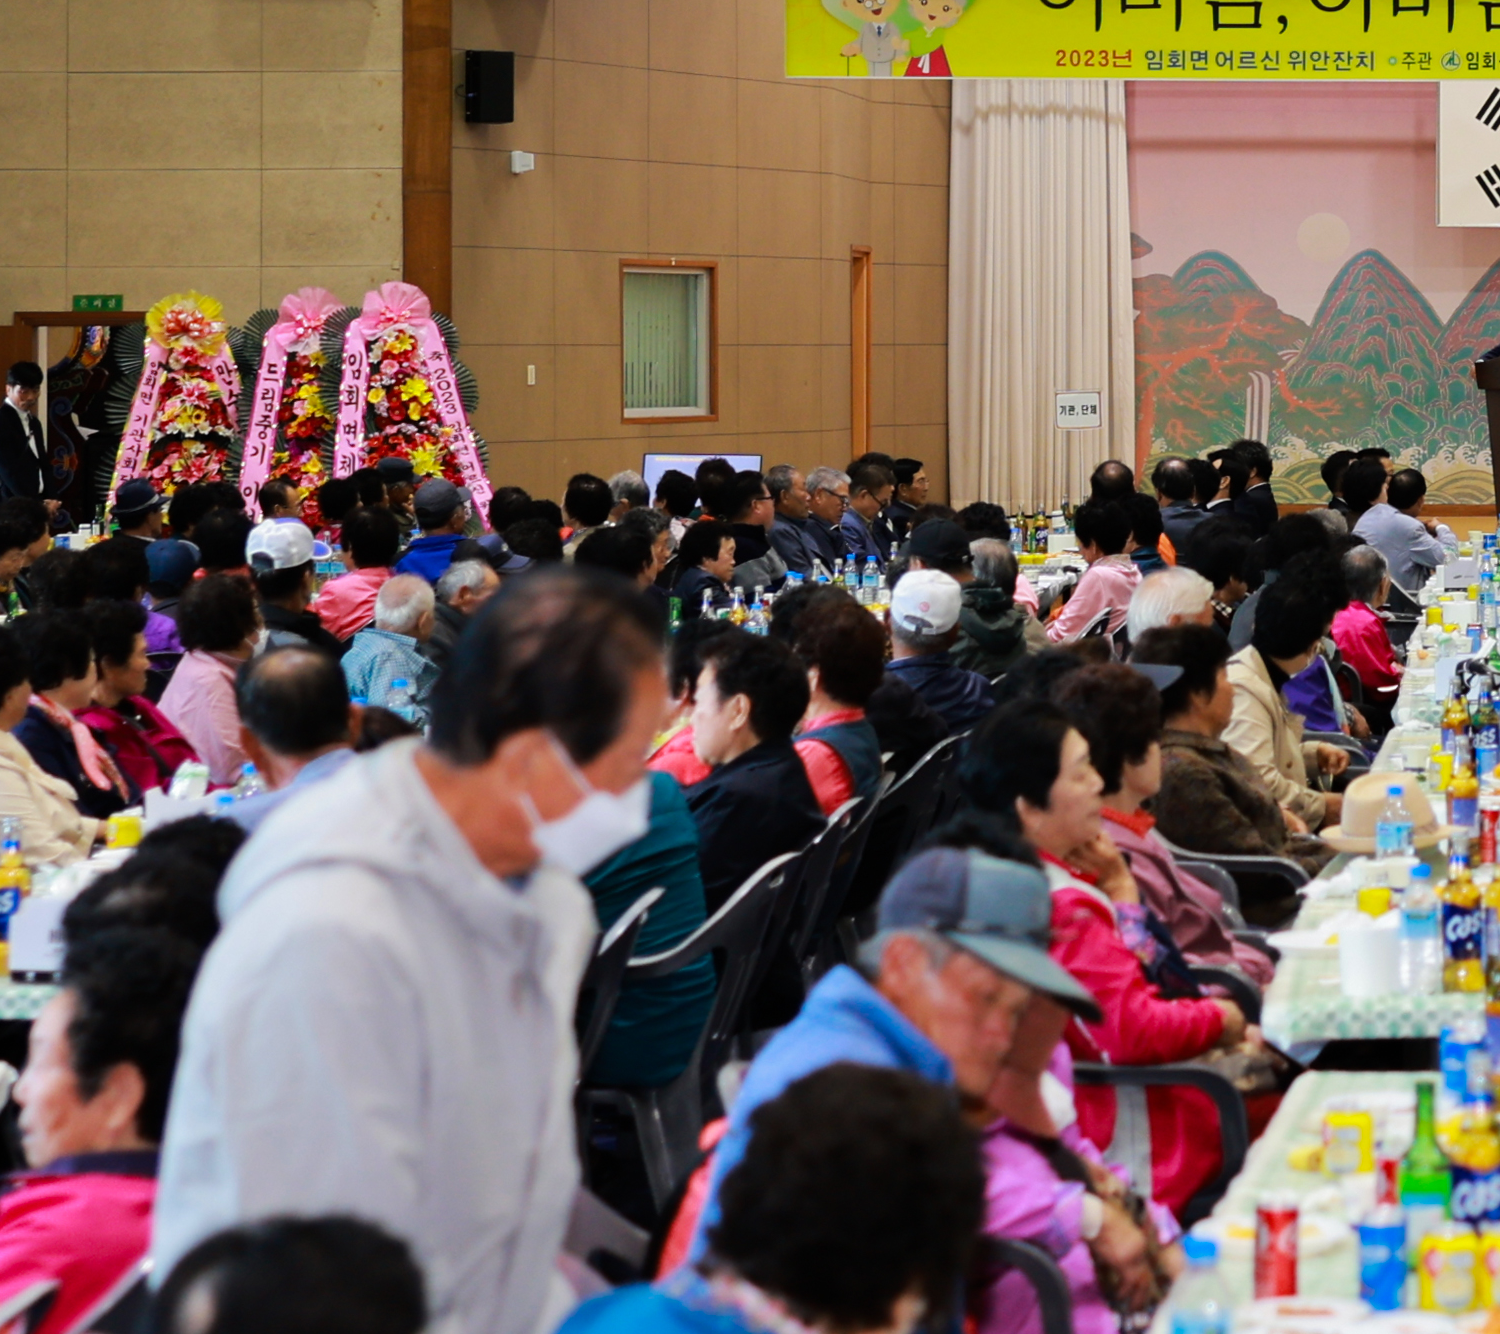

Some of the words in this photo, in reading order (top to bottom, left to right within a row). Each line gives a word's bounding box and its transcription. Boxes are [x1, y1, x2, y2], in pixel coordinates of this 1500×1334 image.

[1055, 49, 1132, 68] 2023년
[1144, 50, 1209, 71] 임회면
[1215, 50, 1280, 71] 어르신
[1287, 51, 1375, 71] 위안잔치
[1401, 51, 1432, 71] 주관
[433, 368, 457, 415] 2023
